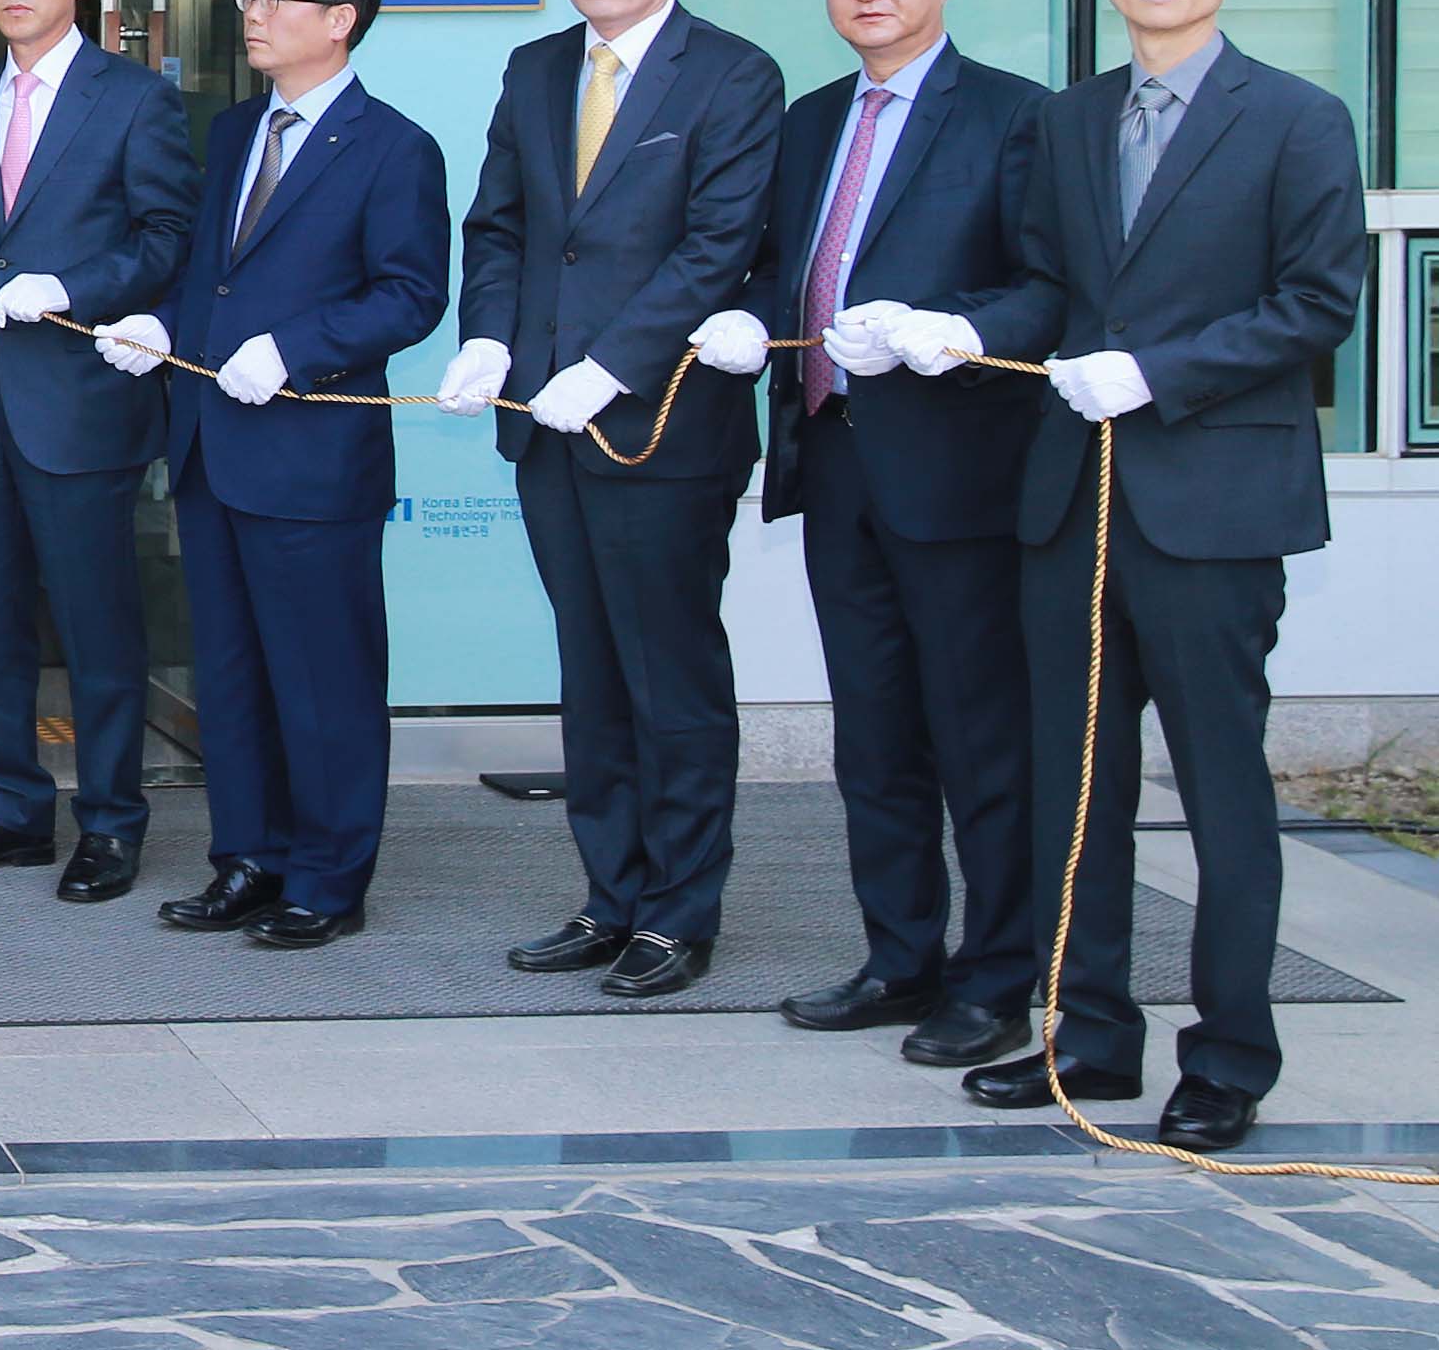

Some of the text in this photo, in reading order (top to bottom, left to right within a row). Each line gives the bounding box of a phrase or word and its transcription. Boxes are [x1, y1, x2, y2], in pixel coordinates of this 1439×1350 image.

[422, 496, 521, 509] Korea Electron
[422, 510, 498, 523] Technology
